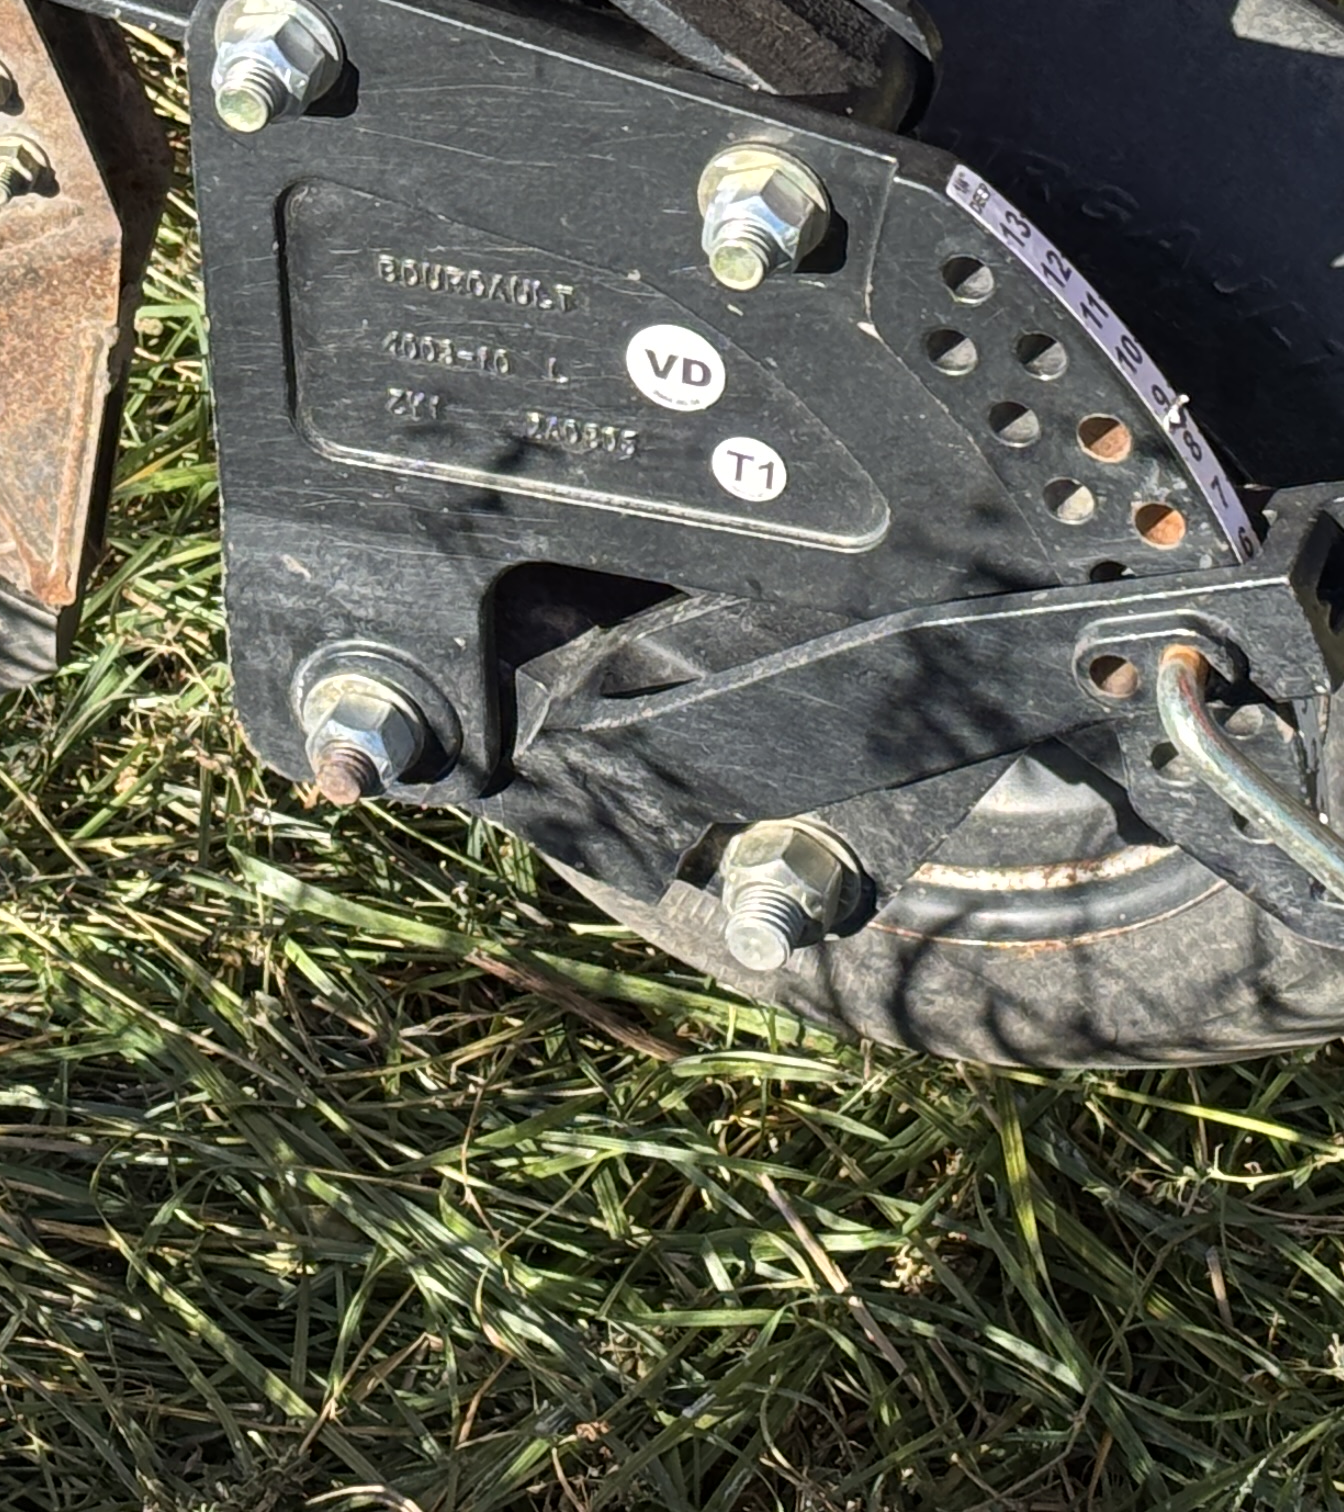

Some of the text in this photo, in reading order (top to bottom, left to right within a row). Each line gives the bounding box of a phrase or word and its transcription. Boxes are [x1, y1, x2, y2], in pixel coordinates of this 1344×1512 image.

[1001, 210, 1032, 247] 13
[1041, 250, 1073, 288] 12
[1080, 291, 1110, 329] 11
[643, 348, 713, 387] VD
[1115, 334, 1144, 373] 10
[1183, 430, 1203, 463] 8
[727, 450, 776, 492] T1
[1210, 474, 1229, 509] 7
[1237, 525, 1255, 559] 6
